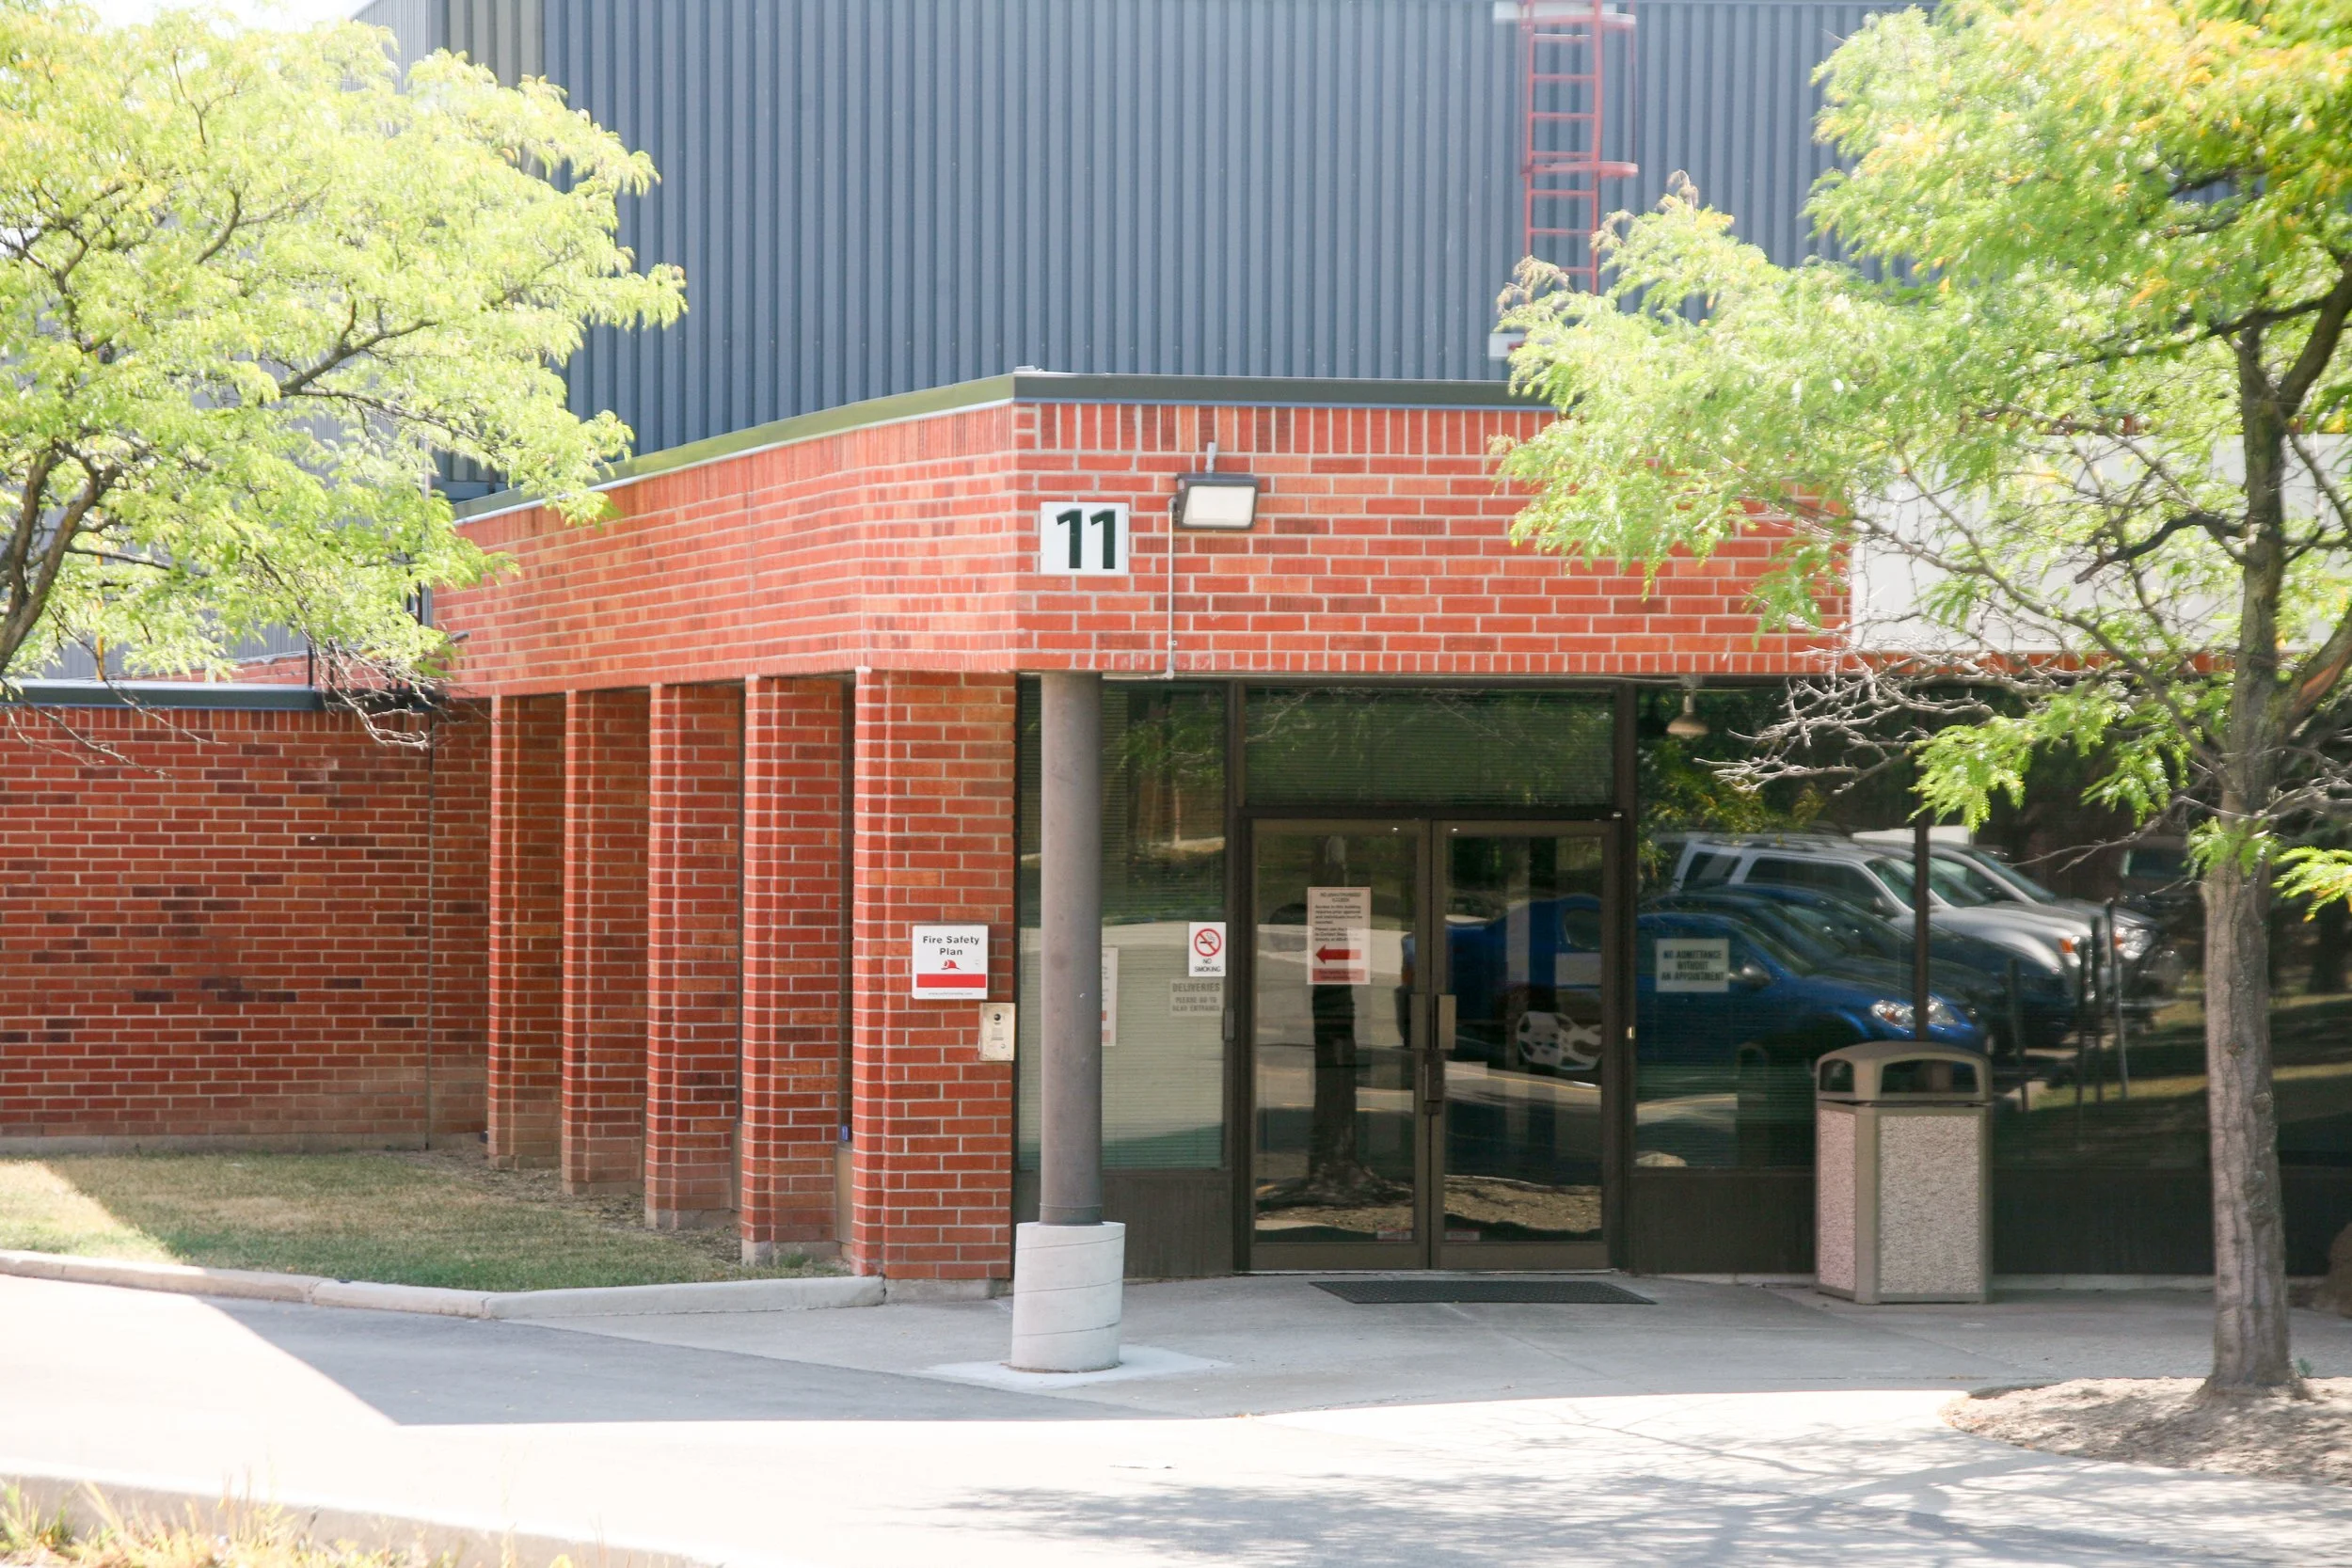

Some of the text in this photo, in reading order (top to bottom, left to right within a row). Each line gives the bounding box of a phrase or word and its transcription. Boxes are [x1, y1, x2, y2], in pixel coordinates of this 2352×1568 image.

[1056, 508, 1116, 569] 11
[923, 935, 979, 945] Fire Safety
[939, 947, 963, 956] Plan
[1172, 982, 1221, 993] DELIVERIES
